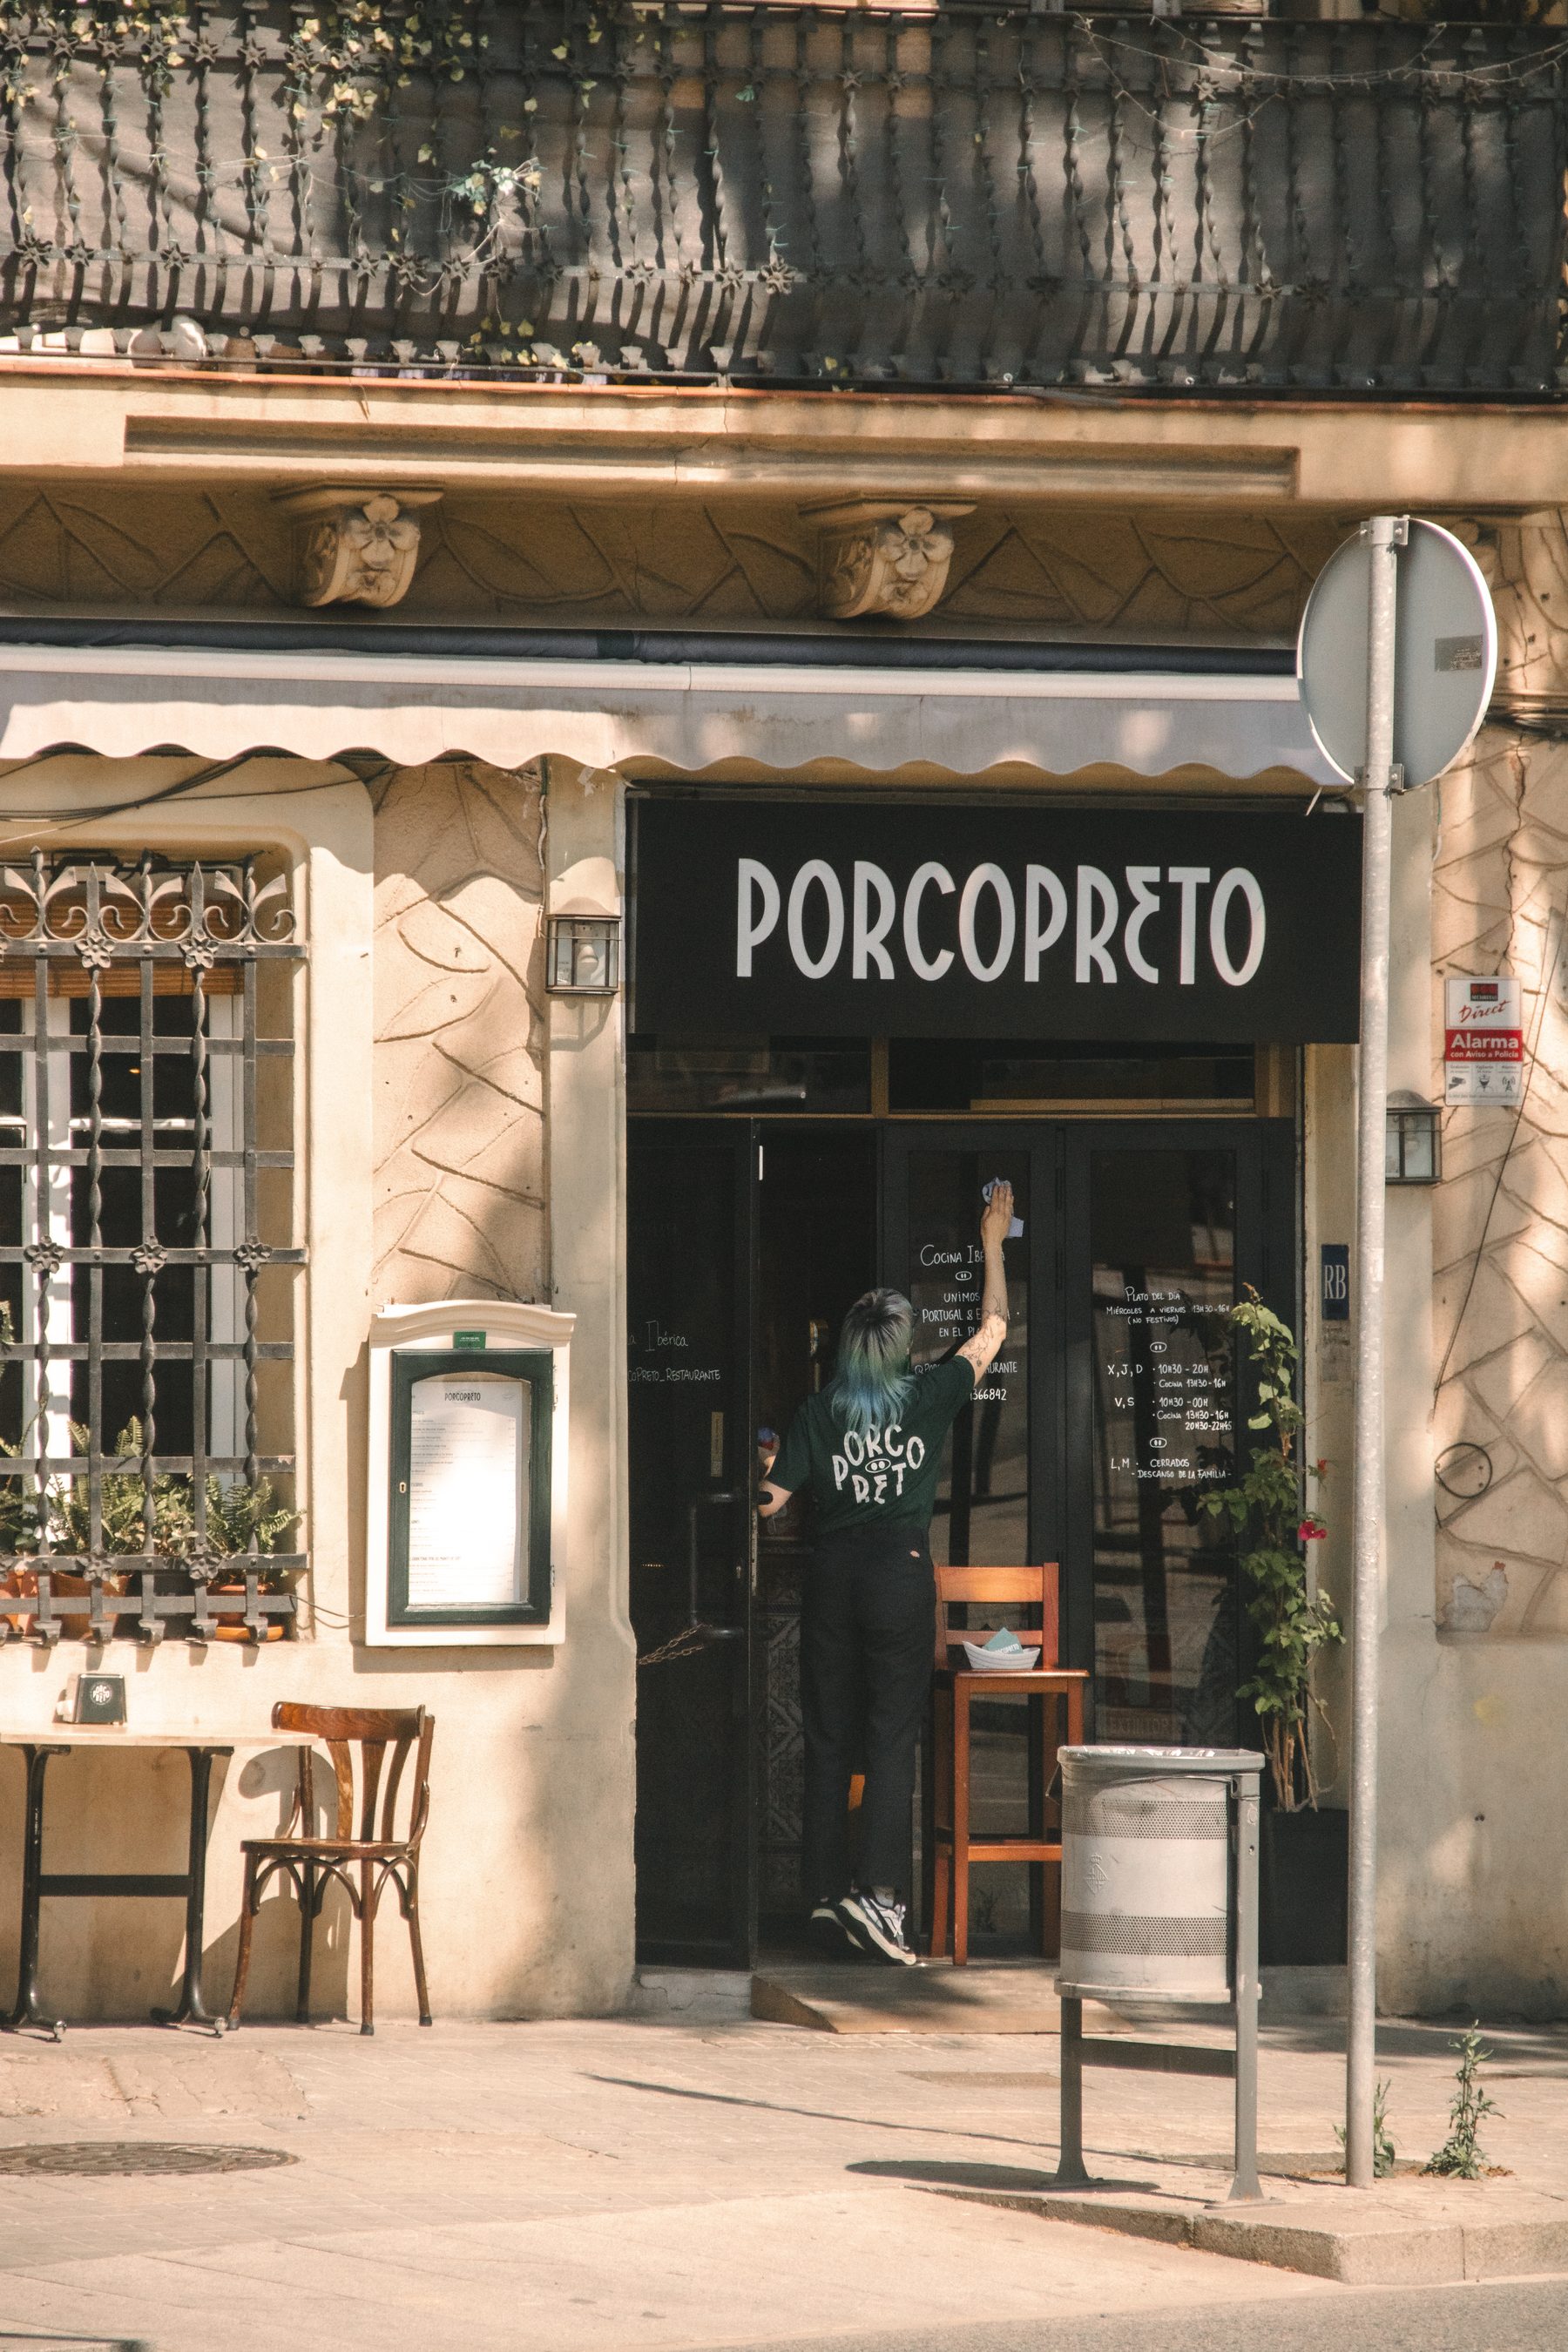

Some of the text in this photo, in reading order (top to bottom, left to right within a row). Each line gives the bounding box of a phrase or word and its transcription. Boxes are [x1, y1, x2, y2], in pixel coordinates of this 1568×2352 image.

[736, 858, 1267, 986] PORCOPRETO
[1458, 1000, 1511, 1023] Direct
[1450, 1033, 1519, 1049] Alarma
[1324, 1265, 1347, 1300] RB
[923, 1308, 963, 1323] PORTUGAL
[939, 1328, 950, 1337] EN
[952, 1327, 963, 1337] EL
[444, 1392, 482, 1402] PORCOPRETO
[1150, 1458, 1190, 1468] CERRADOS
